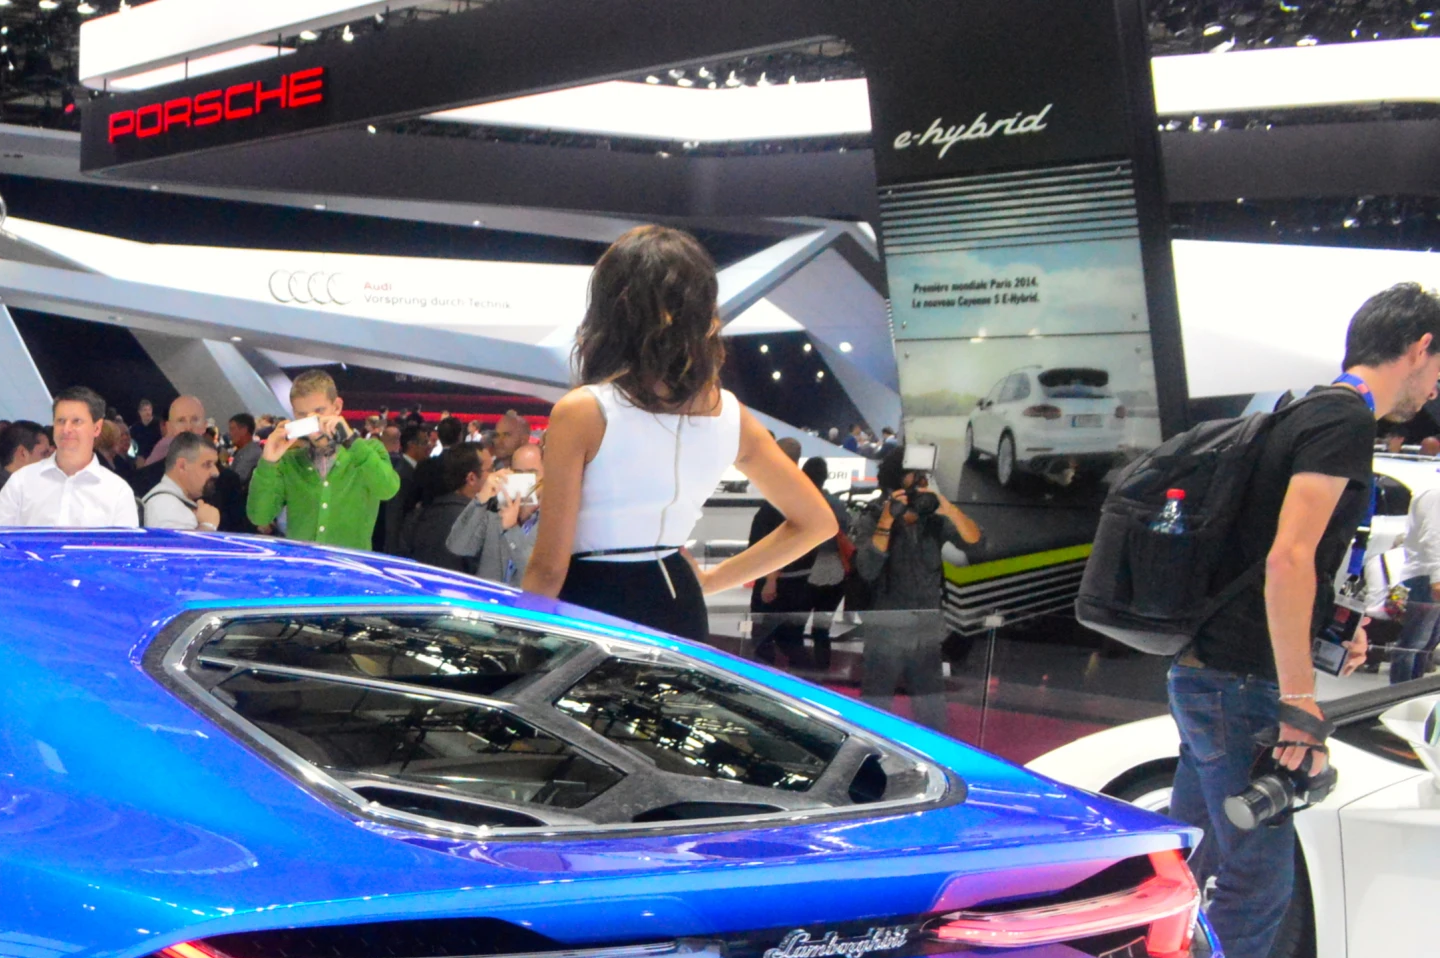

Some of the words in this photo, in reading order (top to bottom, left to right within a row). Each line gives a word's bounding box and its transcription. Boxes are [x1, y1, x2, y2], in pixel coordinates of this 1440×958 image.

[108, 66, 324, 143] PORSCHE
[893, 103, 1054, 160] e-hybrid
[363, 281, 393, 291] Audi
[913, 282, 949, 293] Première
[951, 279, 987, 292] mondiale
[990, 278, 1012, 289] Paris
[363, 294, 428, 308] Vorsprung
[430, 296, 465, 307] durch
[468, 297, 512, 310] Technik
[912, 298, 921, 308] Le
[923, 297, 956, 308] nouveau
[958, 295, 991, 308] Cayenne
[994, 293, 1000, 305] S
